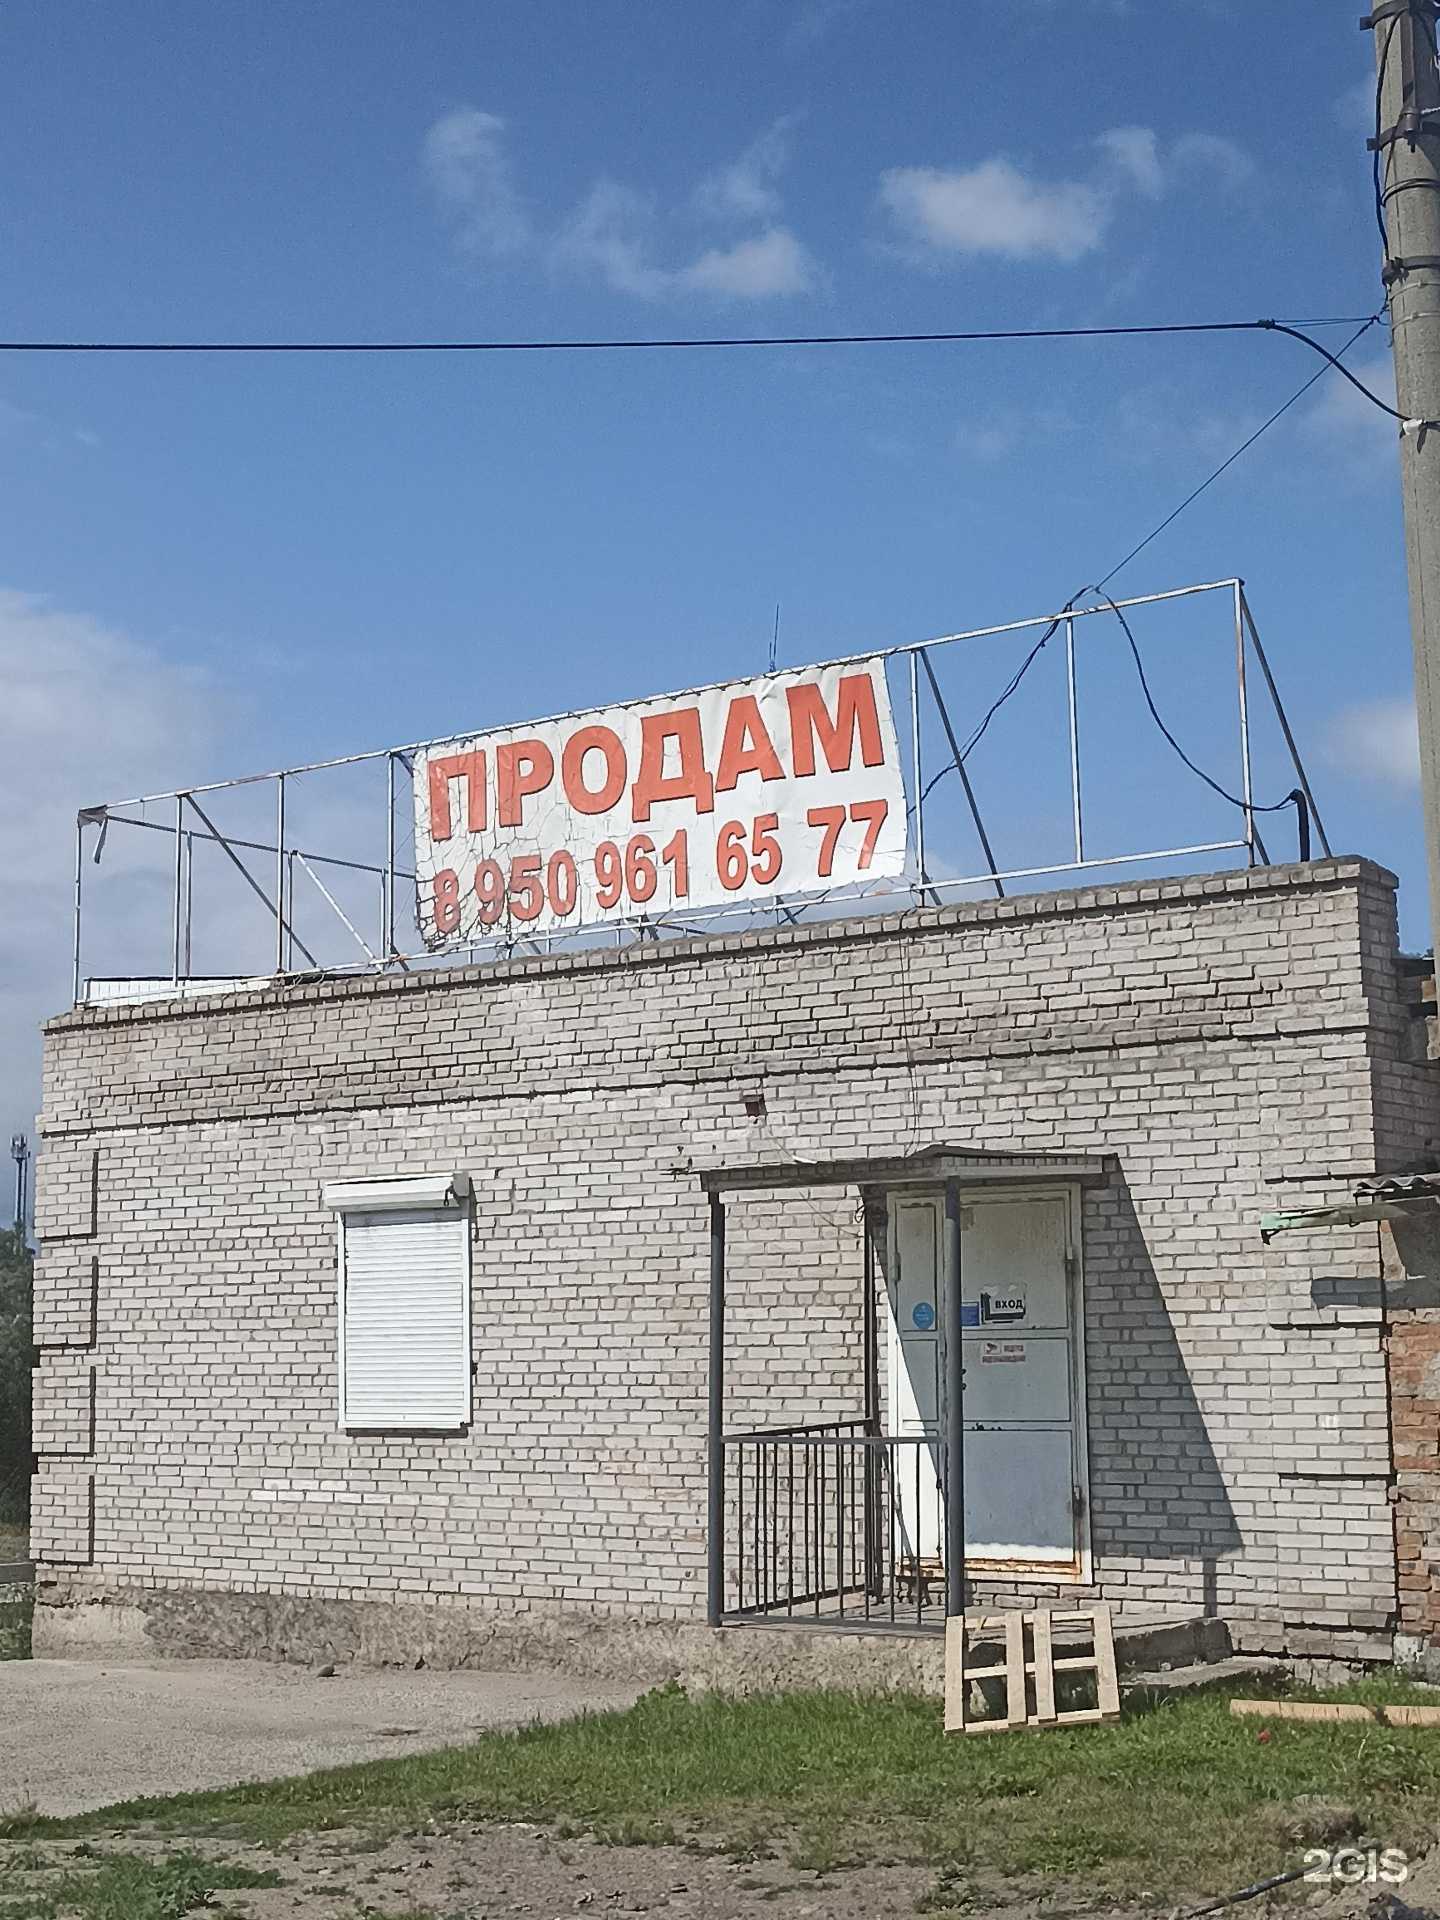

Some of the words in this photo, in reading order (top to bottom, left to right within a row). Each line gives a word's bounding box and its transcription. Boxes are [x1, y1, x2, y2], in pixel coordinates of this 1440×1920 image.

[427, 673, 885, 842] ПРОДАМ
[432, 868, 461, 933] 8
[474, 849, 577, 925] 950
[594, 828, 688, 909] 961
[717, 812, 782, 891] 65
[807, 799, 888, 877] 77
[995, 1299, 1024, 1309] ВХОД
